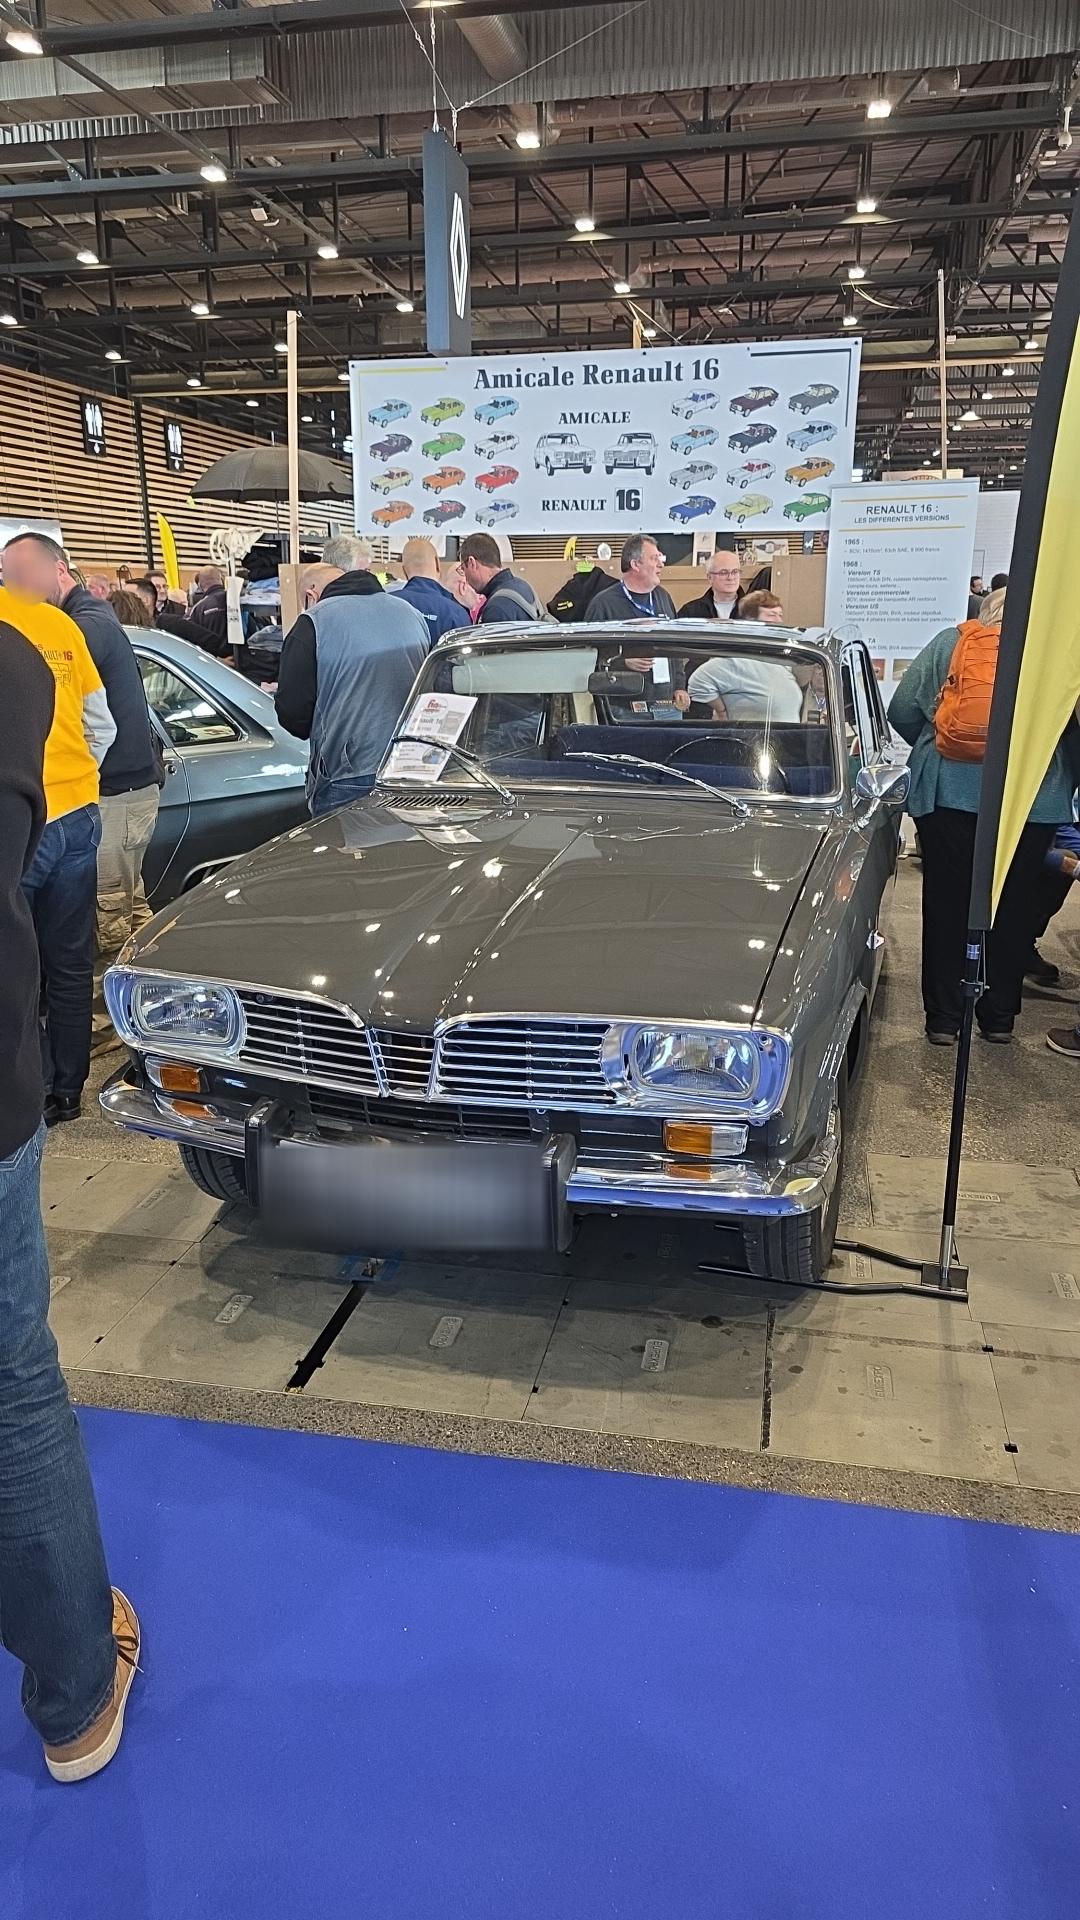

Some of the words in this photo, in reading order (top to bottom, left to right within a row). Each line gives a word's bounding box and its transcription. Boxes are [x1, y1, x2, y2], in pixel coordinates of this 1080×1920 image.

[474, 366, 574, 389] Amicale
[582, 360, 683, 385] Renault
[692, 358, 720, 381] 16
[559, 411, 631, 424] AMICALE
[542, 499, 607, 511] RENAULT
[616, 489, 640, 511] 16
[866, 504, 917, 515] RENAULT
[921, 504, 932, 513] 16
[869, 515, 914, 523] DIFFERENTES
[915, 514, 950, 522] VERSIONS
[63, 651, 73, 660] 16
